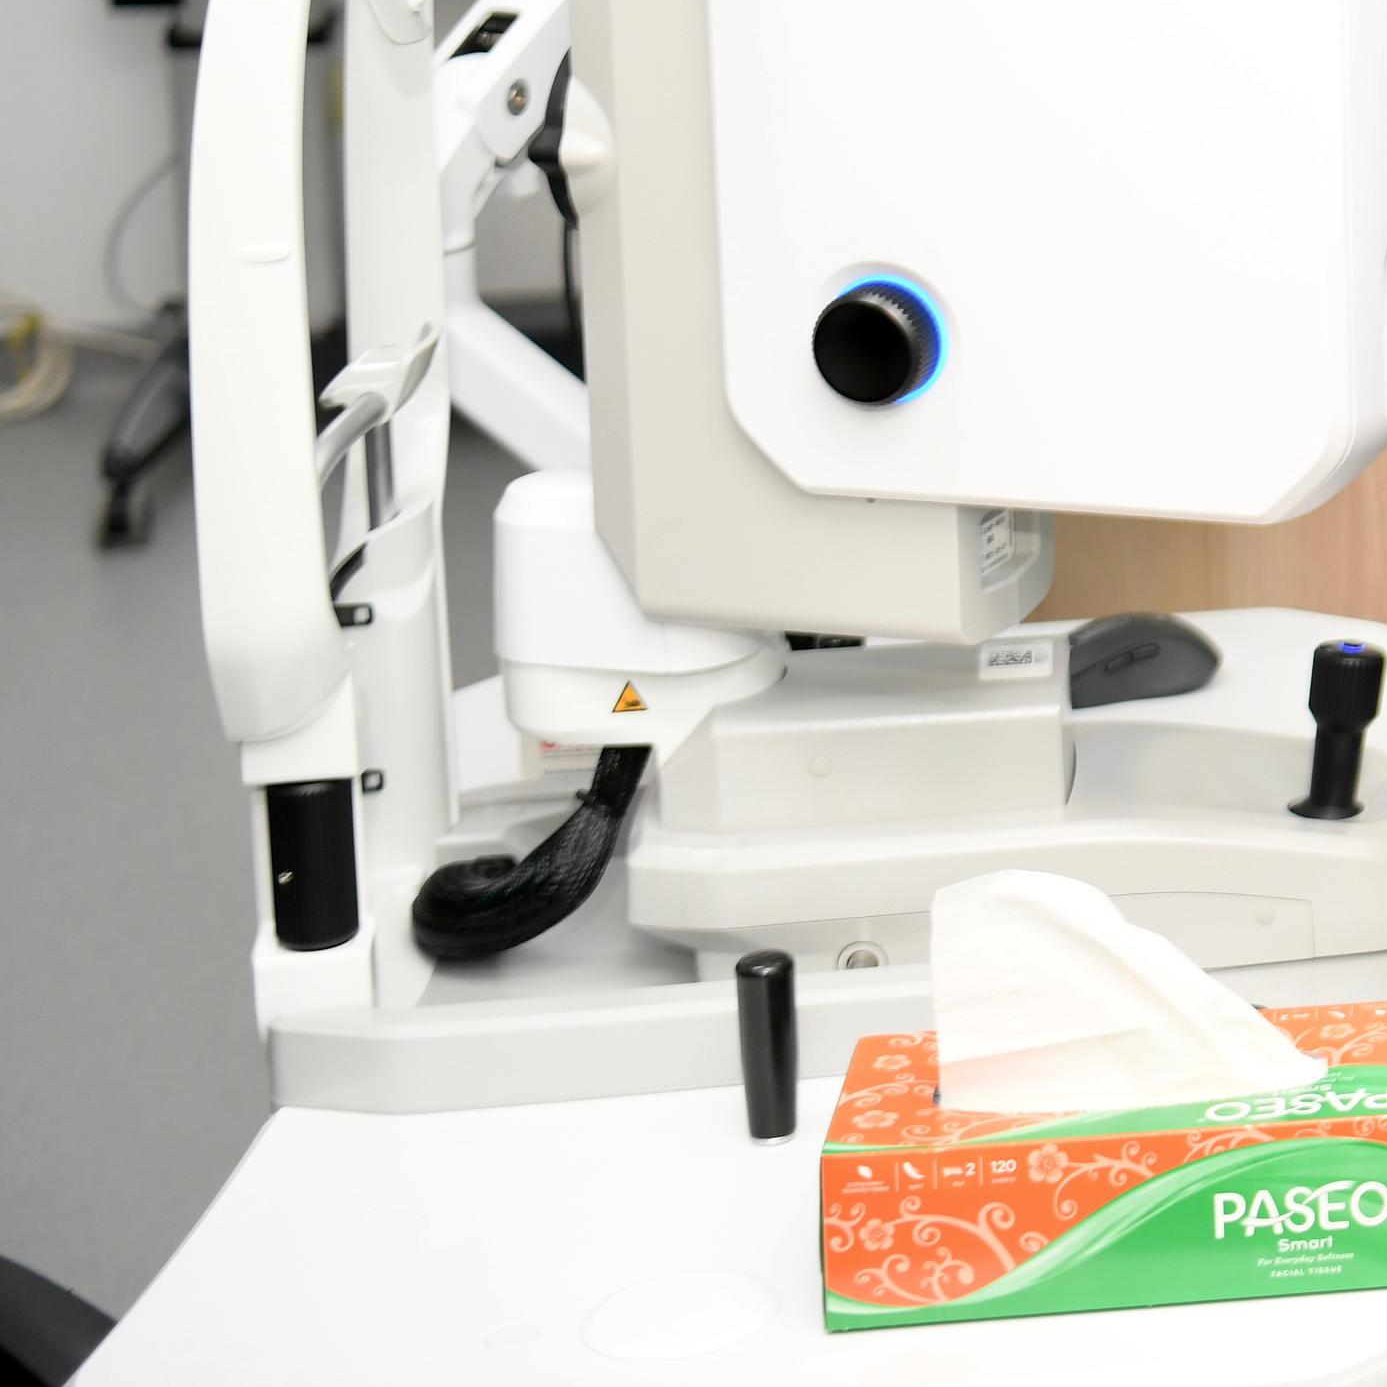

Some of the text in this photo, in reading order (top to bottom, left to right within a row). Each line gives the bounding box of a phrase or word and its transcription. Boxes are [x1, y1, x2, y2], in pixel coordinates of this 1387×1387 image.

[965, 1162, 977, 1177] 2
[991, 1159, 1017, 1174] 120
[1277, 1235, 1334, 1253] Smart
[1275, 1253, 1315, 1266] Everyday
[1270, 1265, 1343, 1278] FACIAL TISSUE
